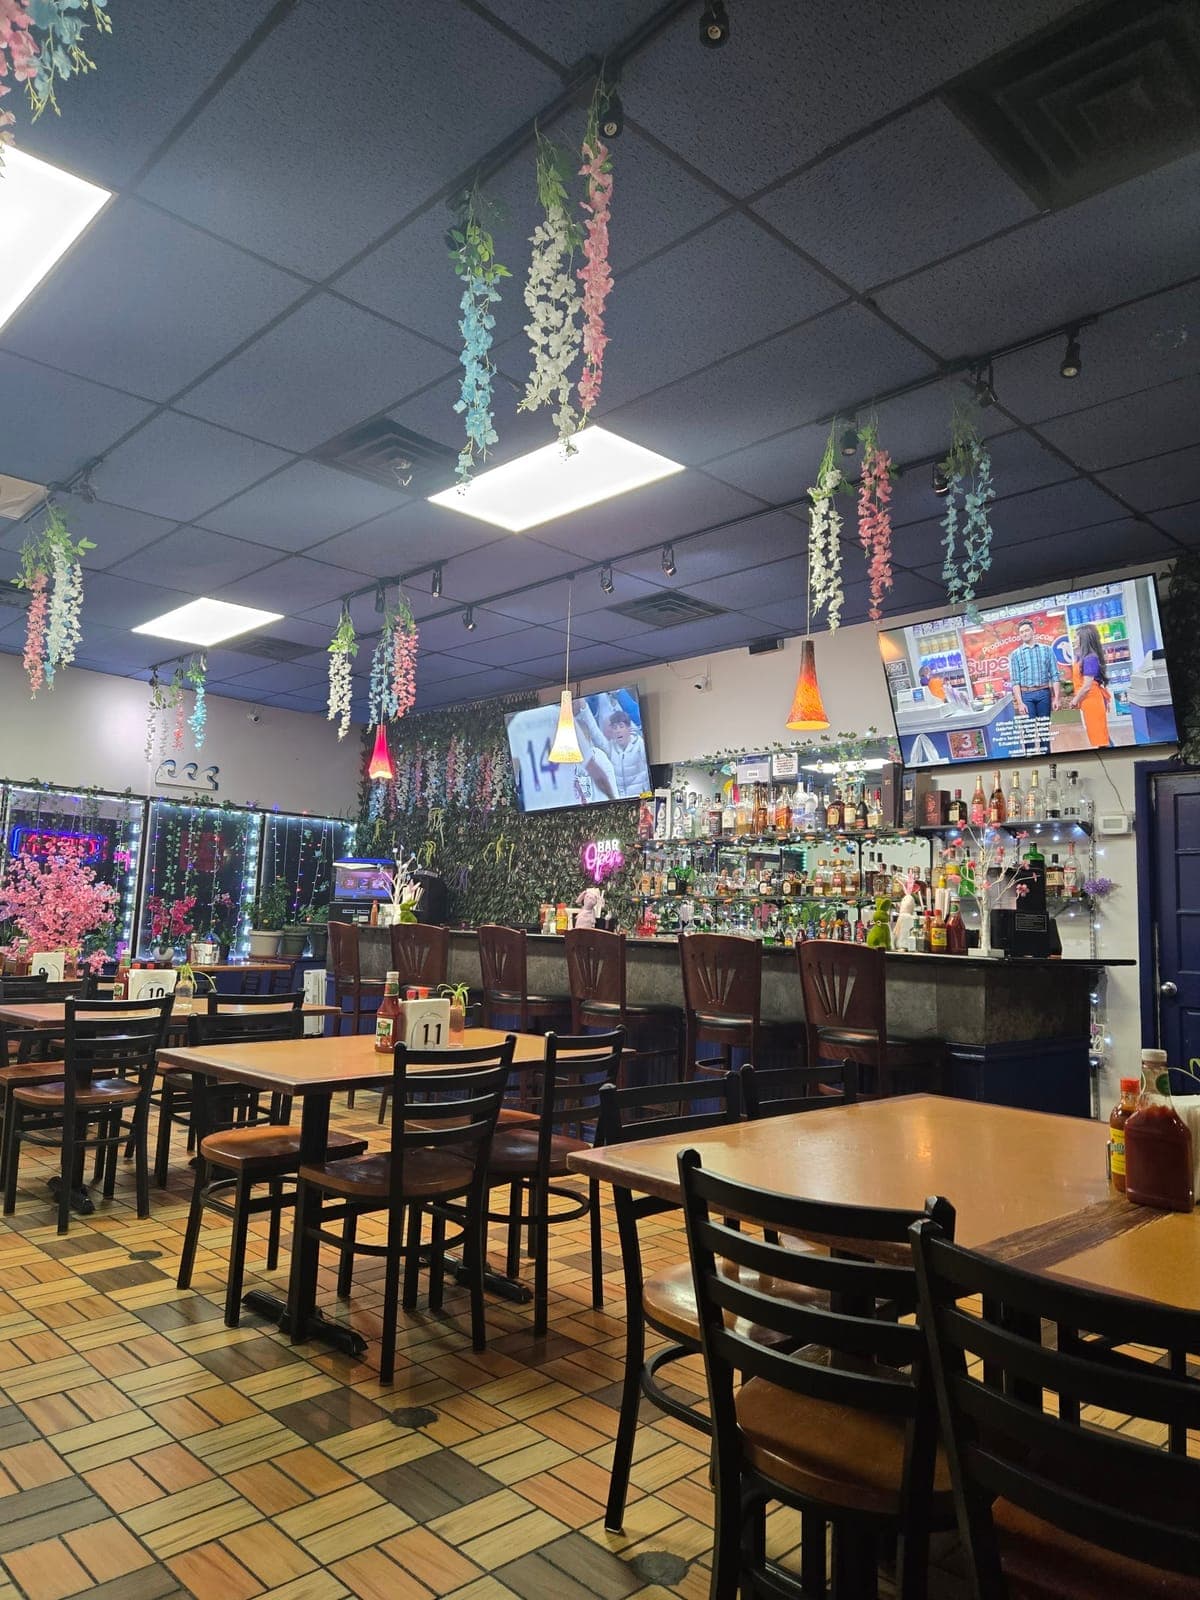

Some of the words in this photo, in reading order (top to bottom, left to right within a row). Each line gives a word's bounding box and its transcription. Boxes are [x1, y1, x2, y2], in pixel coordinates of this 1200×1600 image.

[982, 636, 1021, 654] Productos
[967, 656, 1010, 677] Supe
[961, 734, 972, 748] 3
[526, 736, 560, 792] 14
[597, 839, 619, 853] BAR
[584, 842, 624, 882] Open
[148, 987, 165, 999] 10
[423, 1023, 442, 1045] 11
